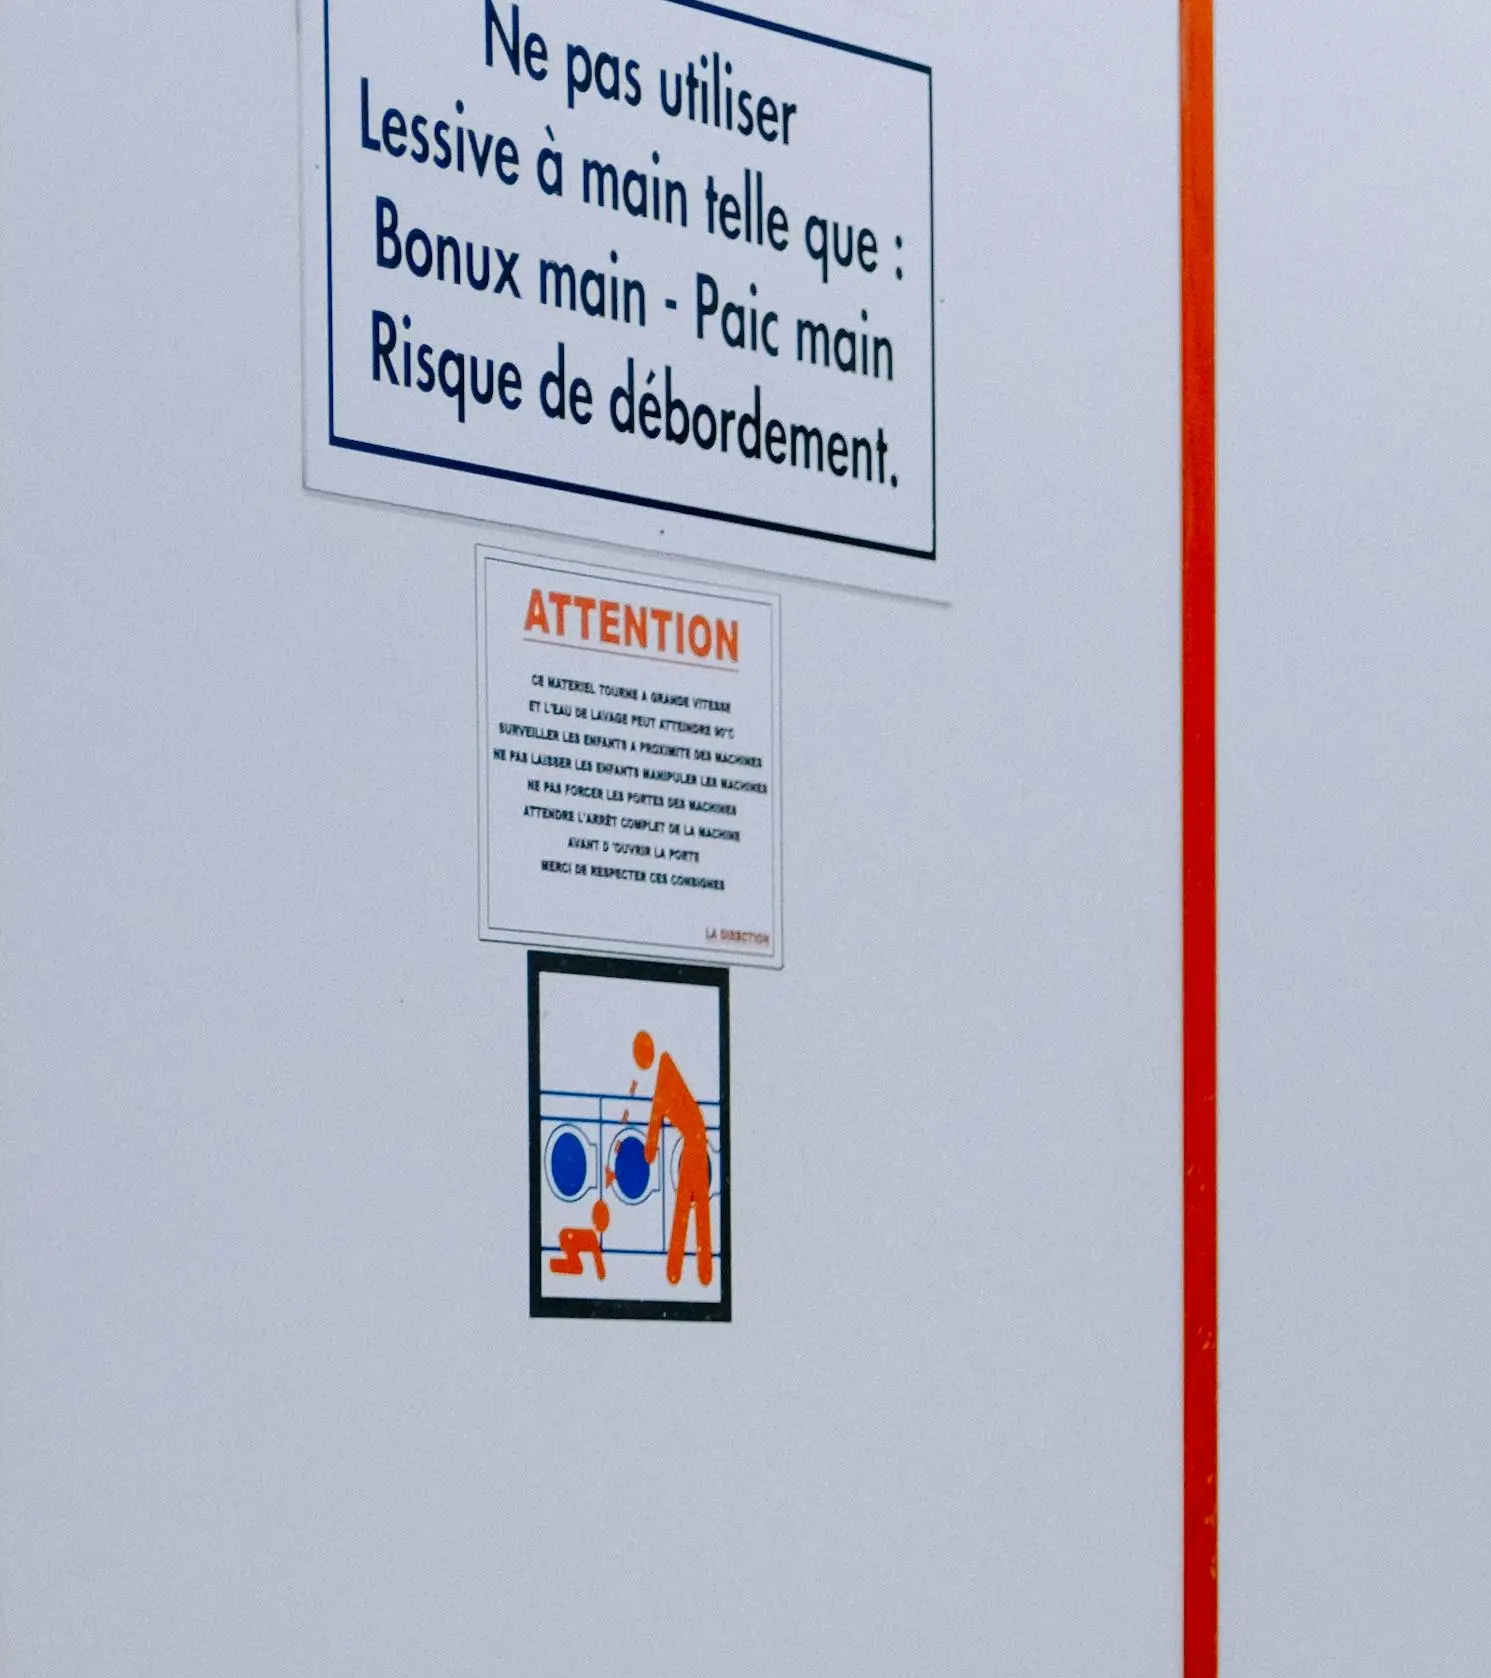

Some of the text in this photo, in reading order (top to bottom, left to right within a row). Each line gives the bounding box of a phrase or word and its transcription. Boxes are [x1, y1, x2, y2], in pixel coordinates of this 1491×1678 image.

[485, 0, 797, 145] Ne pas utiliser
[361, 77, 903, 283] Lessive à main telle que :
[376, 196, 893, 380] Bonux main - Paic main
[372, 310, 897, 487] Risque de débordement.
[524, 588, 738, 662] ATTENTION
[528, 699, 656, 728] ET L'EAU DE LAVAGE PEUT
[498, 722, 560, 741] SURVEILLER
[562, 731, 581, 745] LES
[583, 734, 628, 751] ENFANTS
[630, 741, 636, 752] A
[694, 749, 712, 762] DES
[493, 748, 506, 761] NE
[509, 750, 528, 764] PAS
[575, 759, 593, 773] LES
[595, 761, 640, 778] ENFANTS
[700, 776, 718, 788] LES
[527, 779, 540, 792] NE
[543, 781, 562, 794] PAS
[564, 783, 604, 800] FORCER
[606, 789, 624, 802] LES
[627, 791, 665, 807] PORTES
[667, 797, 686, 810] DES
[523, 805, 575, 823] ATTENDRE
[620, 817, 666, 833] COMPLET
[668, 823, 681, 835] DE
[683, 826, 695, 837] LA
[567, 837, 600, 850] AVANT
[654, 848, 666, 859] LA
[668, 848, 700, 863] PORTE
[541, 860, 572, 874] MERCI
[575, 863, 587, 876] DE
[590, 865, 647, 882] RESPECTER
[649, 872, 668, 885] CES
